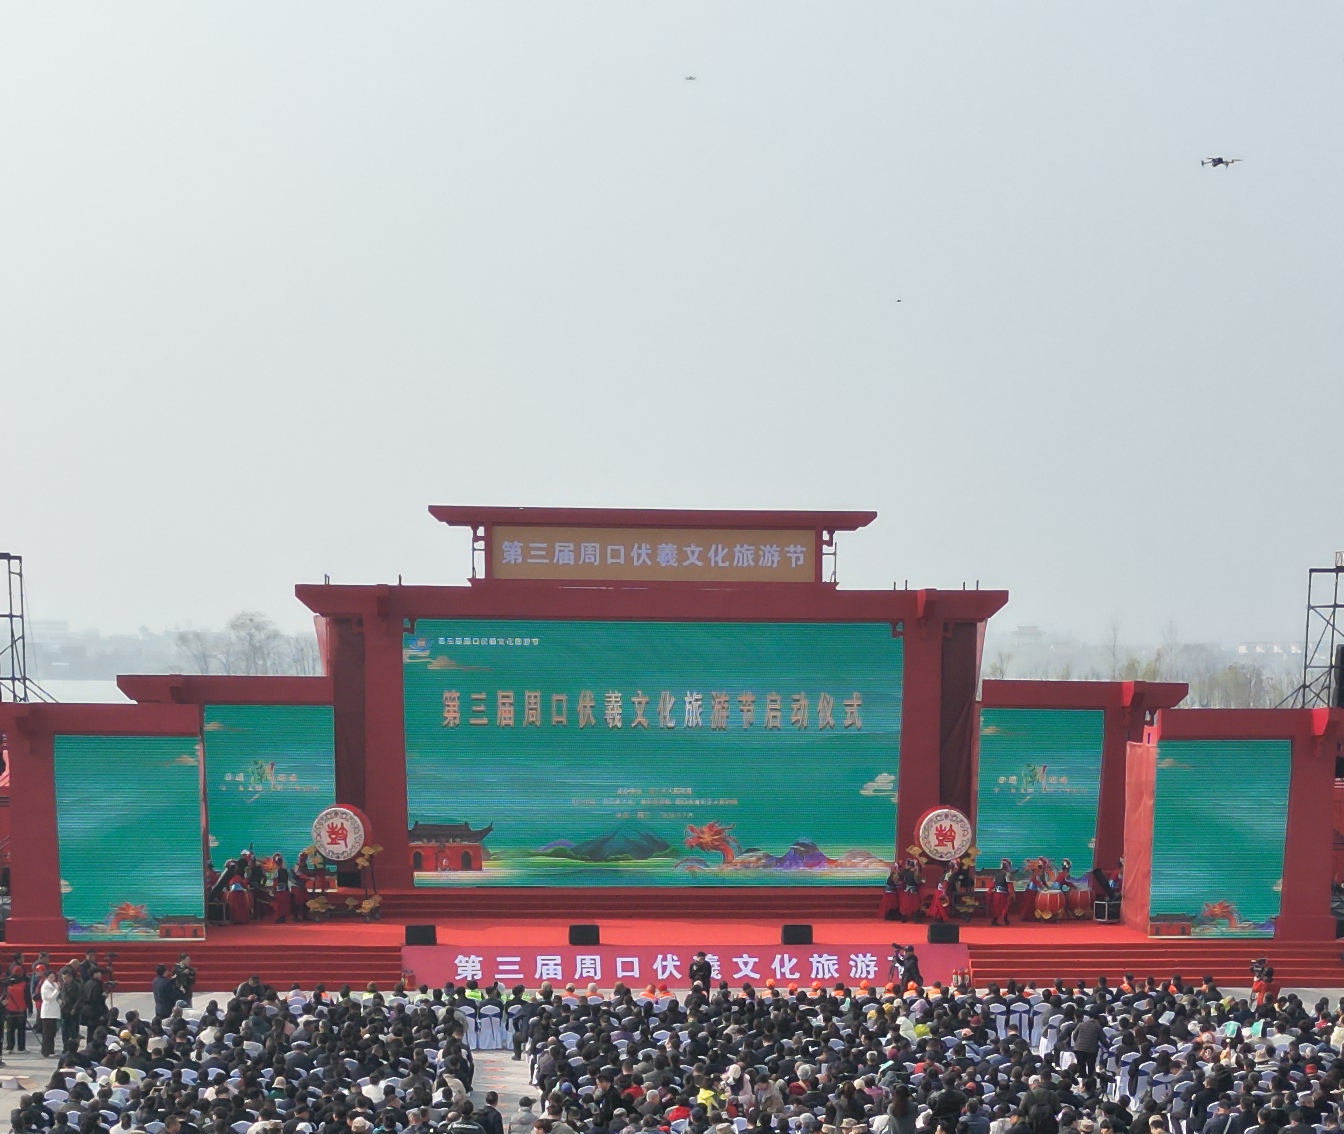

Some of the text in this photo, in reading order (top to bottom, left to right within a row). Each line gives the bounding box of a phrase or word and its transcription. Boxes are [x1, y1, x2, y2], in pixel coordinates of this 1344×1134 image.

[501, 540, 807, 568] 第三届周口伏羲文化旅游节
[442, 690, 863, 730] 第三届周口伏羲文化旅游节启动仪式
